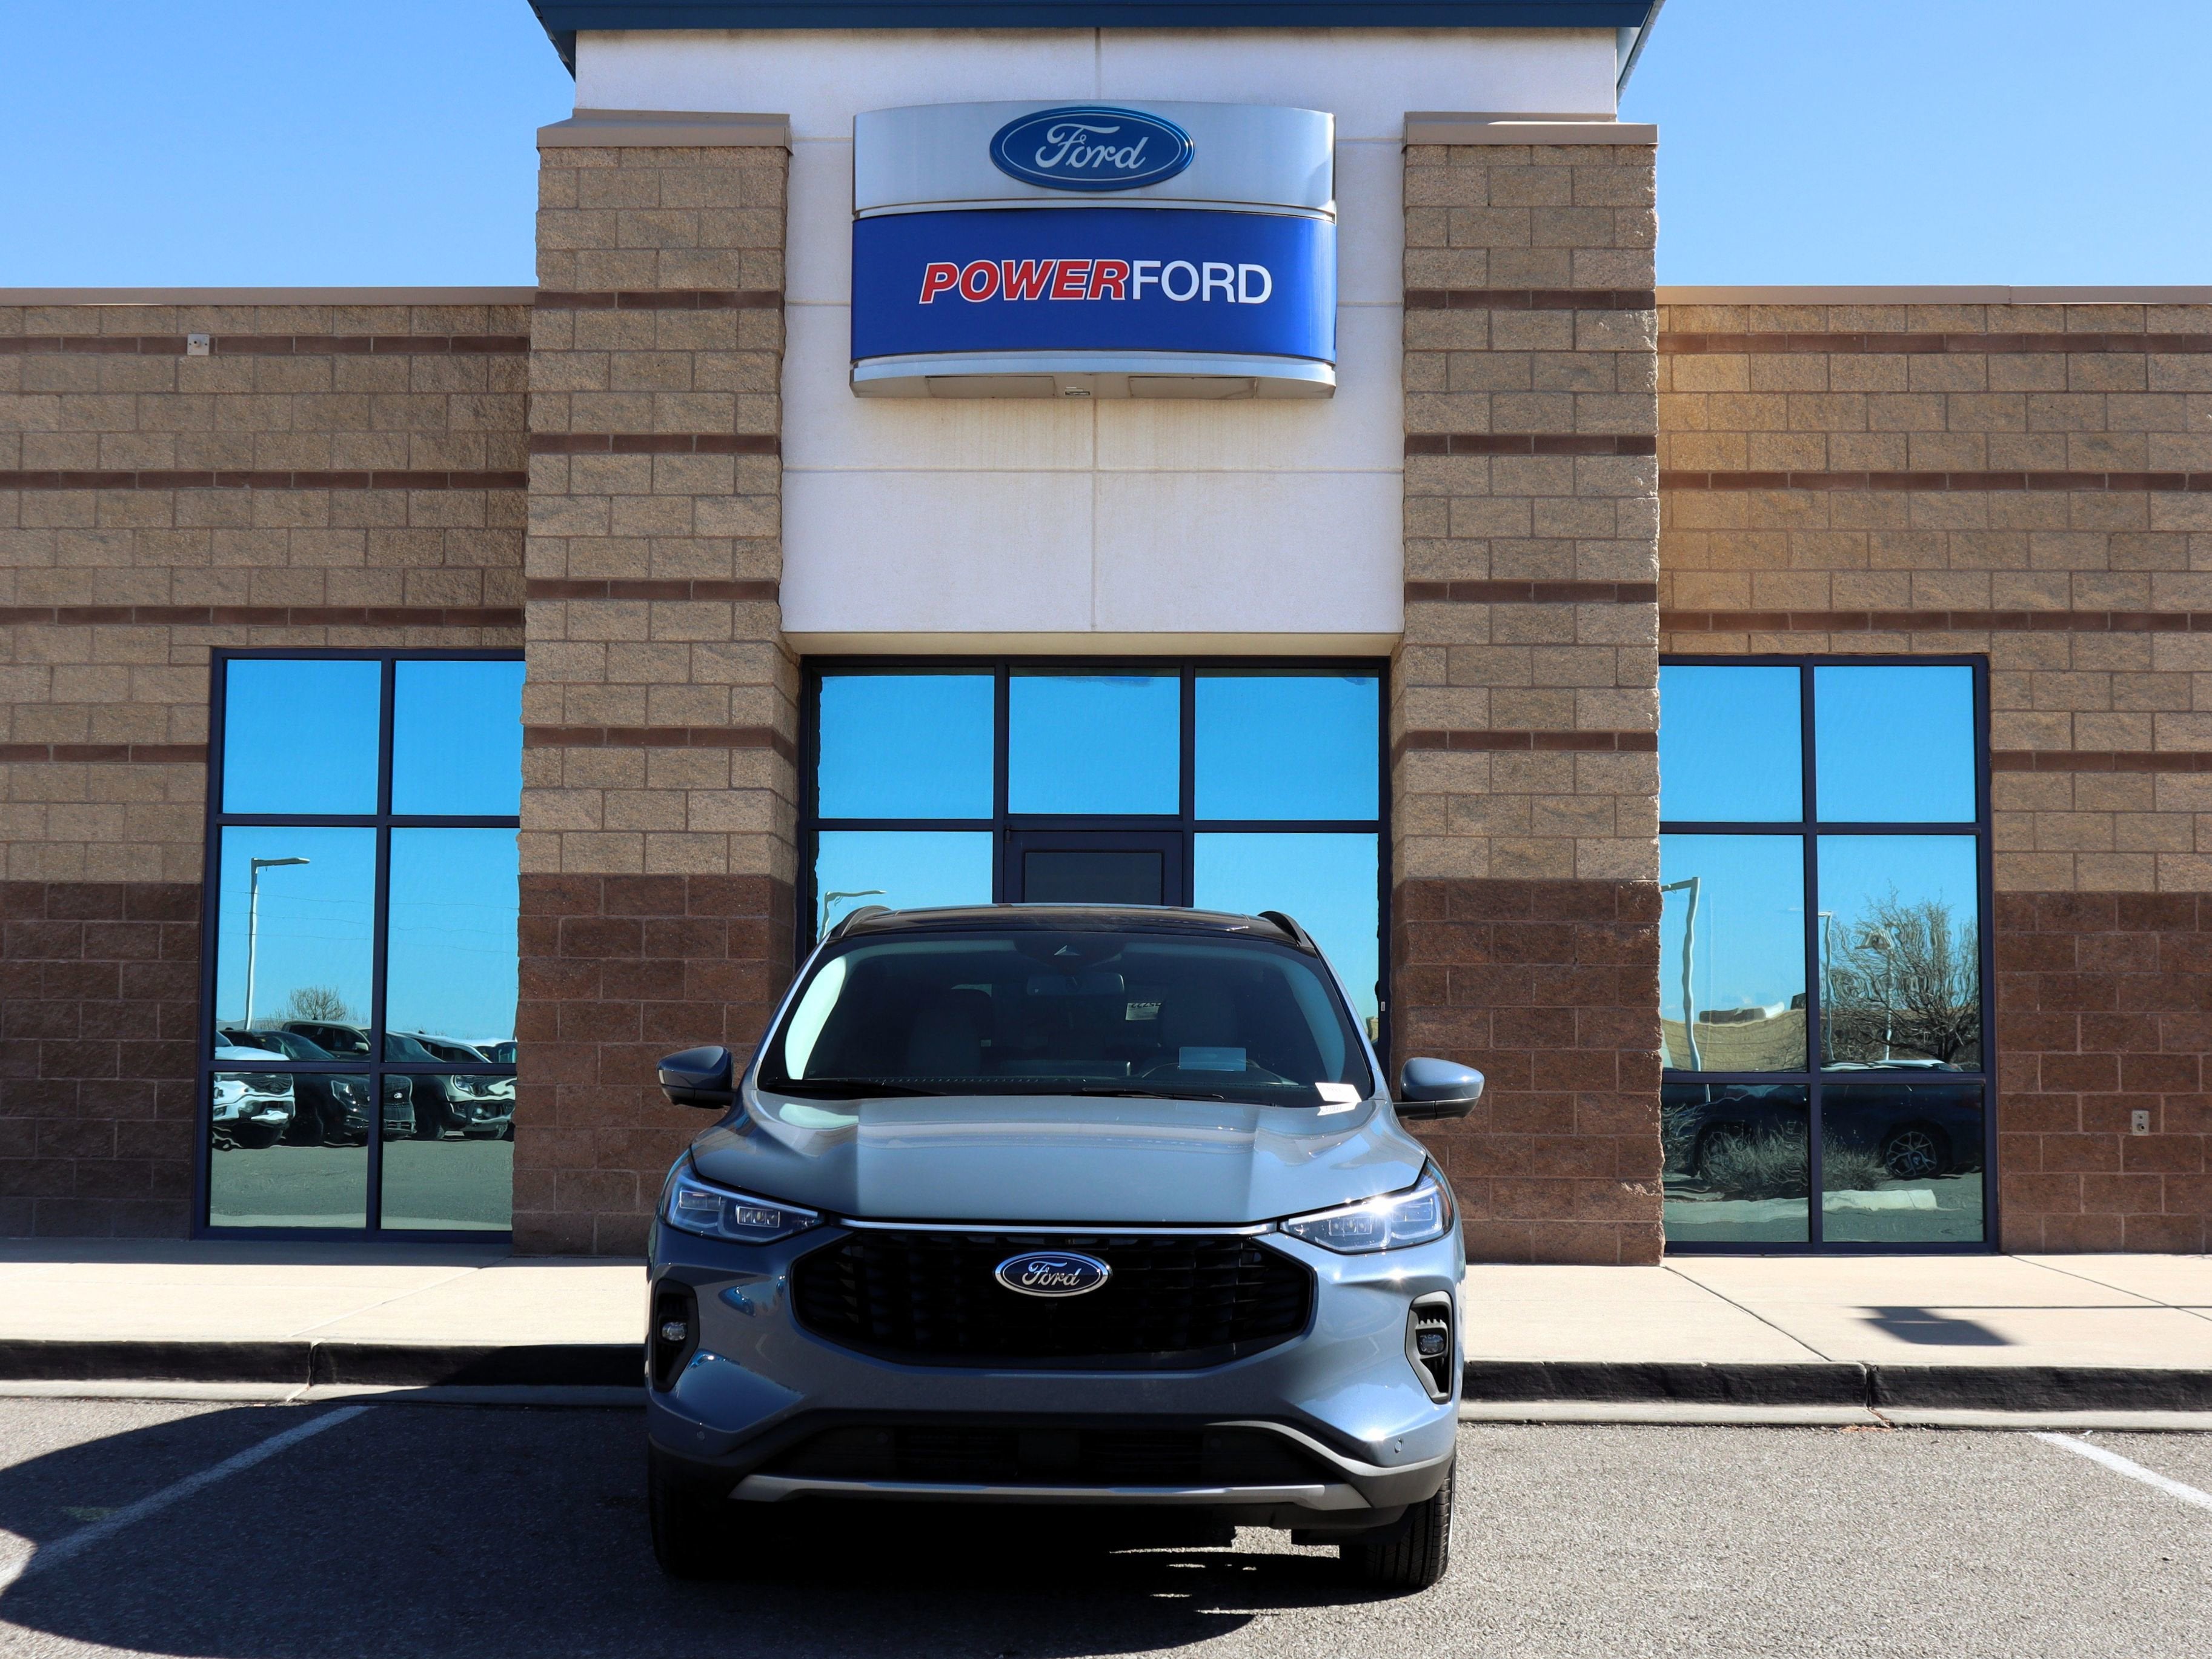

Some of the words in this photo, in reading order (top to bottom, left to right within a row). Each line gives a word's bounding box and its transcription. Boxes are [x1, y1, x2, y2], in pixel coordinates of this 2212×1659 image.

[1036, 123, 1148, 168] Ford
[919, 259, 1272, 304] POWERFORD
[1021, 1260, 1082, 1286] Ford
